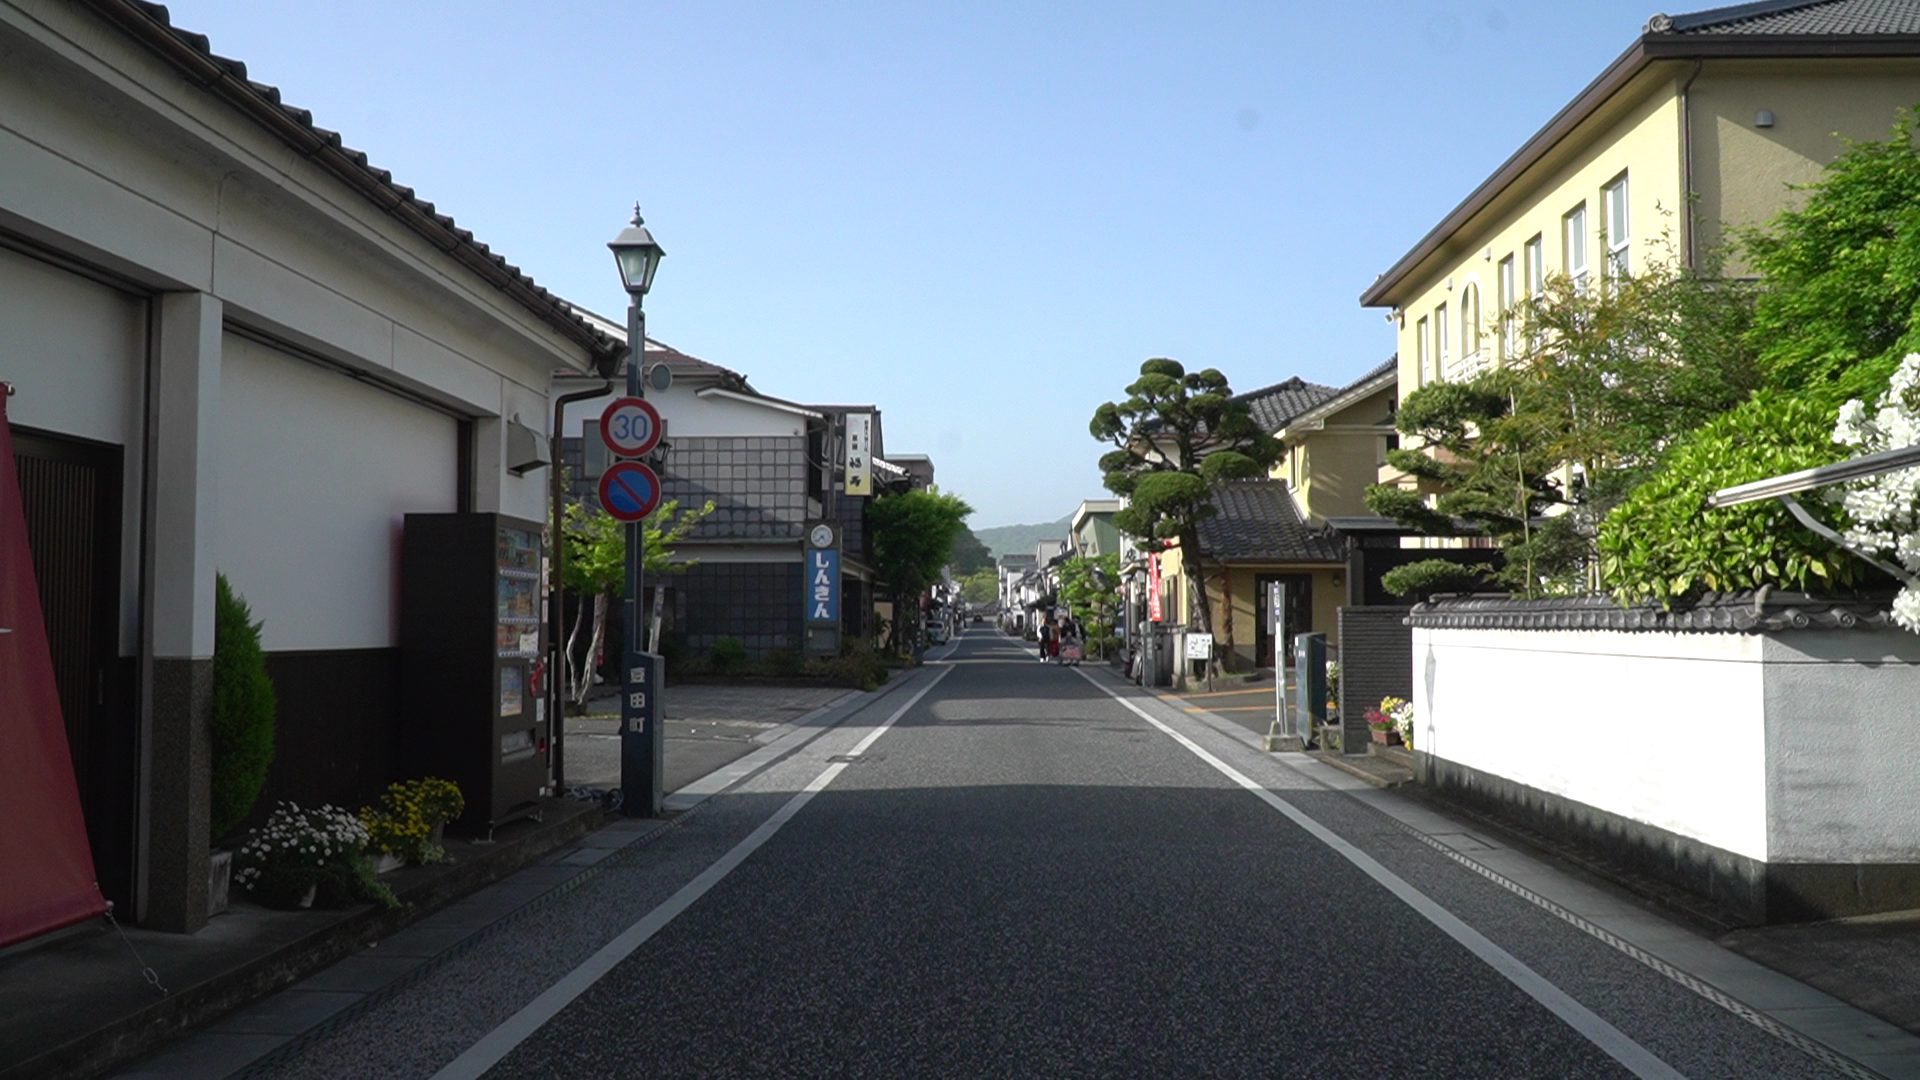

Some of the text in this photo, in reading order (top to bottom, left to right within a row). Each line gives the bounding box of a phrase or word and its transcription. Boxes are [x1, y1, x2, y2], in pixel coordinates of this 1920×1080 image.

[614, 414, 648, 440] 30
[814, 552, 830, 618] しんきん
[629, 666, 645, 733] 豆田町
